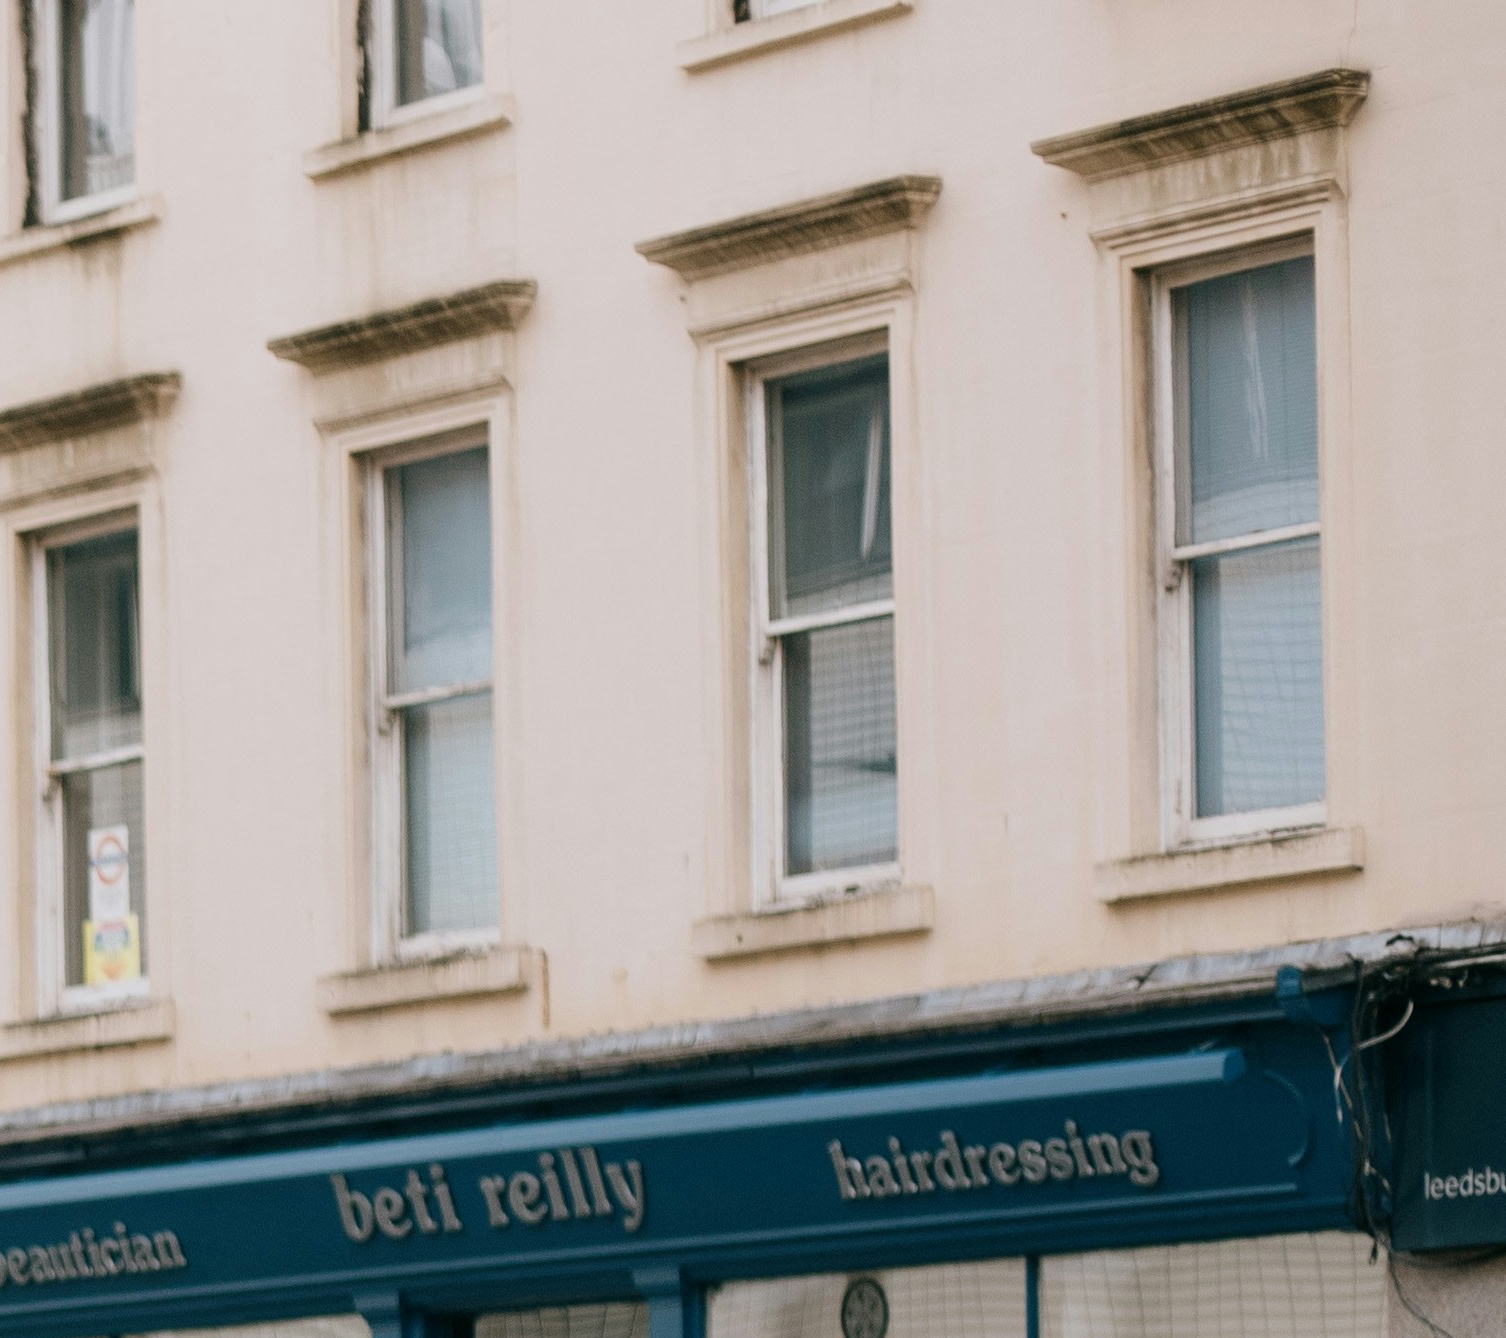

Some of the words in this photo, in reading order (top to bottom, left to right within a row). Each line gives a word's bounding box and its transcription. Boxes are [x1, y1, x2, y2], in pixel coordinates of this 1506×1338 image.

[330, 1163, 462, 1244] beti
[478, 1145, 644, 1233] reilly
[828, 1119, 1162, 1202] hairdressing
